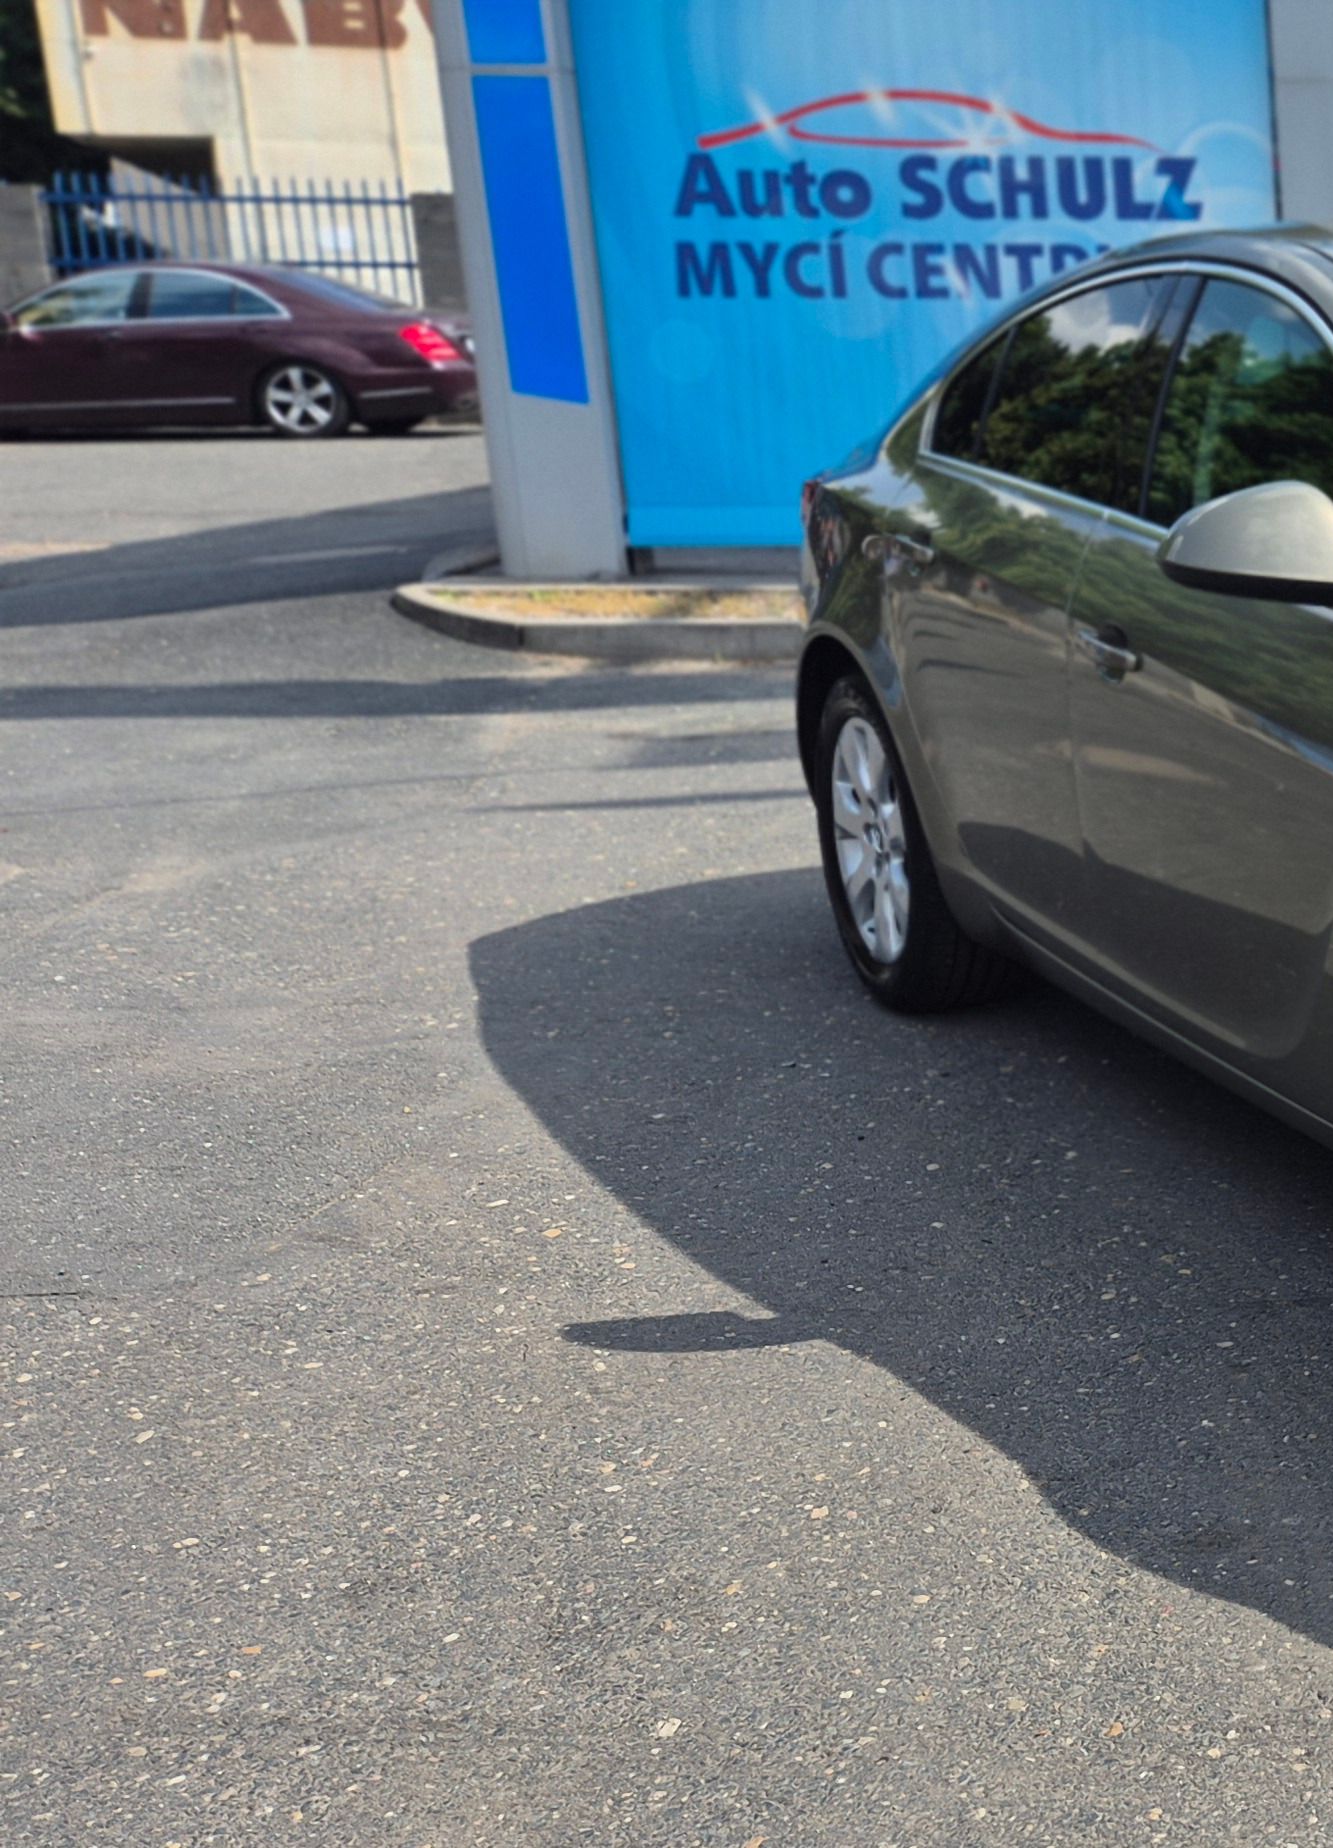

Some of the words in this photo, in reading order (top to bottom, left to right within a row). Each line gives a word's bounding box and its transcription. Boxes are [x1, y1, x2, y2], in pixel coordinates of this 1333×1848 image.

[82, 0, 434, 50] NAB
[674, 153, 873, 219] Auto
[900, 154, 1202, 221] SCHULZ
[675, 229, 848, 298] MYCÍ
[866, 243, 1110, 300] CENT
